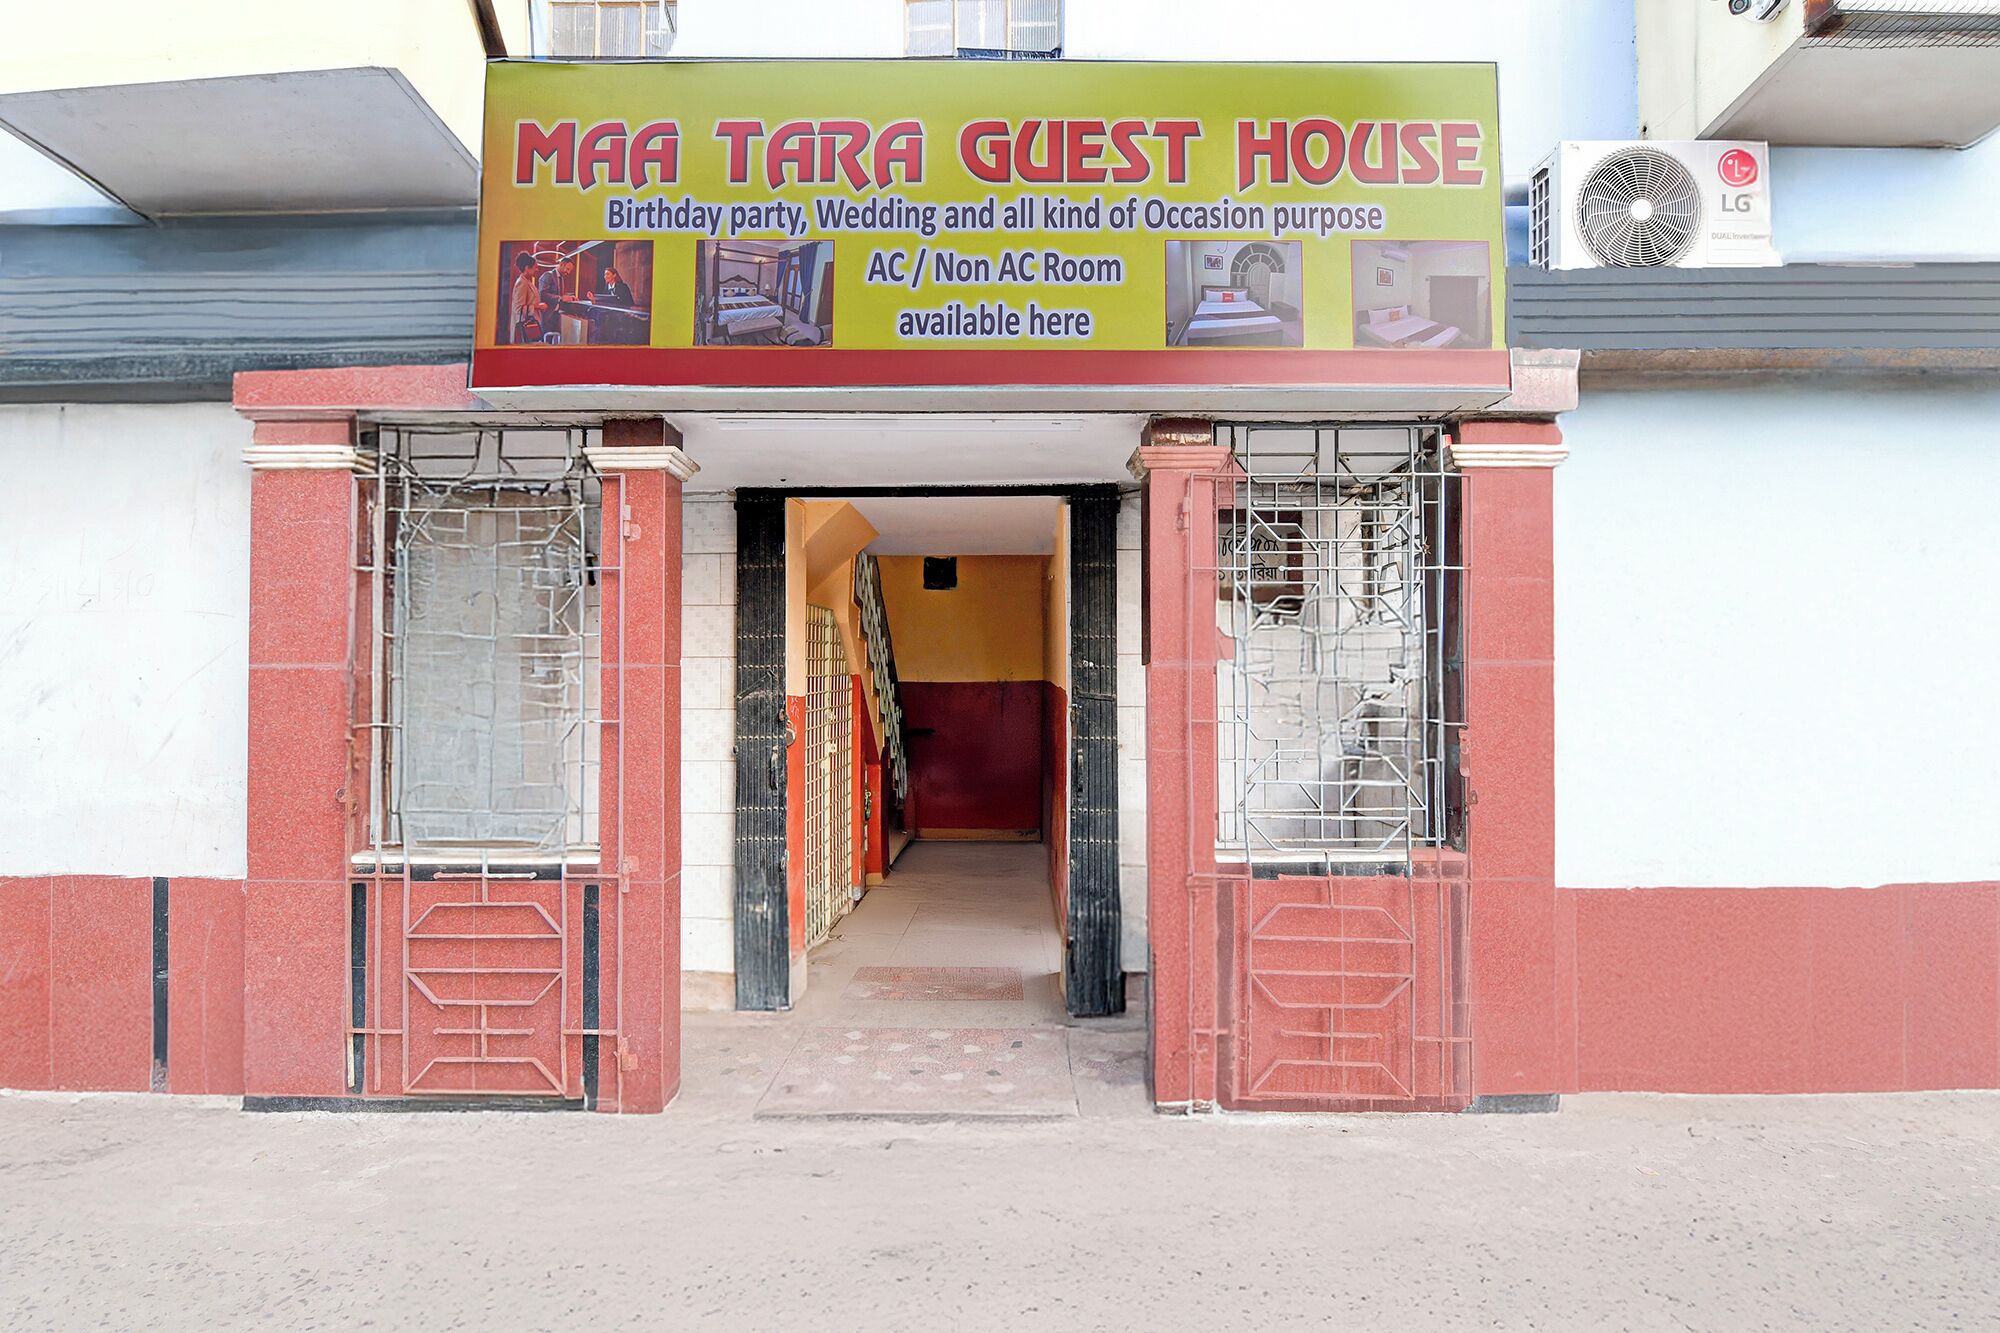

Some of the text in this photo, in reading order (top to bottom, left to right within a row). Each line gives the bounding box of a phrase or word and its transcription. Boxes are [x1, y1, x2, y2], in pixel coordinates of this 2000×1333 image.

[516, 119, 1483, 191] MAA TARA GUEST HOUSE
[609, 198, 1382, 237] Birthday party, Wedding and all kind of Occasion purpose
[1721, 193, 1753, 213] LG
[867, 252, 905, 282] AC
[936, 252, 990, 282] Non
[997, 252, 1035, 282] AC
[1045, 252, 1122, 282] Room
[899, 303, 1090, 336] available here
